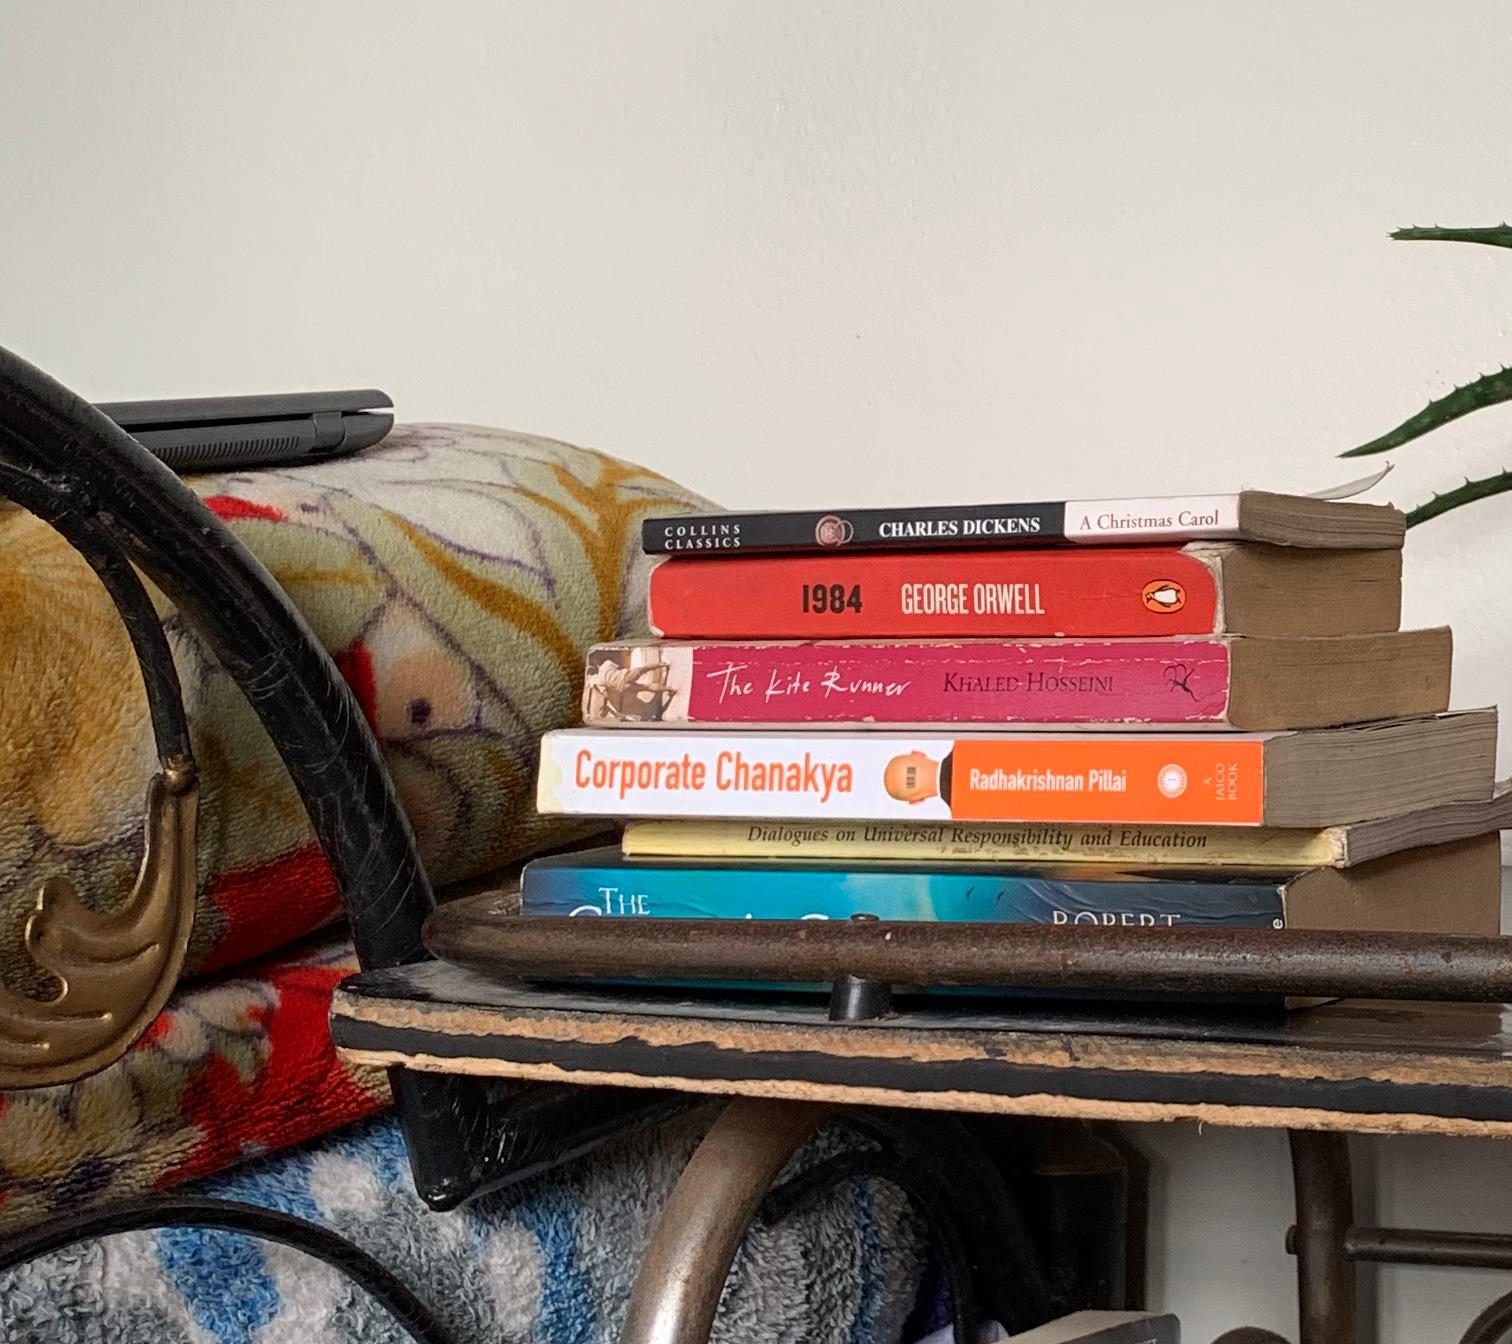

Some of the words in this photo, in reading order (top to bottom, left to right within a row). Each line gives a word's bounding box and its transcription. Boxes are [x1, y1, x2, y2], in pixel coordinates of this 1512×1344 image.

[664, 524, 741, 537] COLLINS
[879, 520, 958, 538] CHARLES
[963, 517, 1041, 535] DICKENS
[1079, 516, 1091, 530] A
[1096, 511, 1174, 529] Christmas
[1178, 510, 1219, 526] Carol
[664, 537, 741, 550] CLASSICS
[802, 583, 863, 613] 1984
[901, 583, 969, 615] GEORGE
[973, 583, 1045, 615] ORWELL
[706, 664, 753, 704] The
[820, 665, 912, 698] Runner
[943, 672, 1019, 693] KHALED
[1025, 672, 1113, 693] HOSSEINI
[575, 747, 706, 800] Corporate
[715, 751, 853, 803] Chanakya
[969, 768, 1084, 791] Radhakrishnan
[1088, 769, 1127, 792] Pillai
[1215, 763, 1226, 801] JAICO
[1228, 763, 1239, 801] BOOK
[747, 826, 828, 847] Dialogues
[836, 829, 856, 842] on
[863, 826, 943, 844] Universal
[951, 827, 1073, 850] Responsibility
[1080, 829, 1113, 846] and
[1119, 830, 1208, 848] Education
[598, 887, 651, 916] THE
